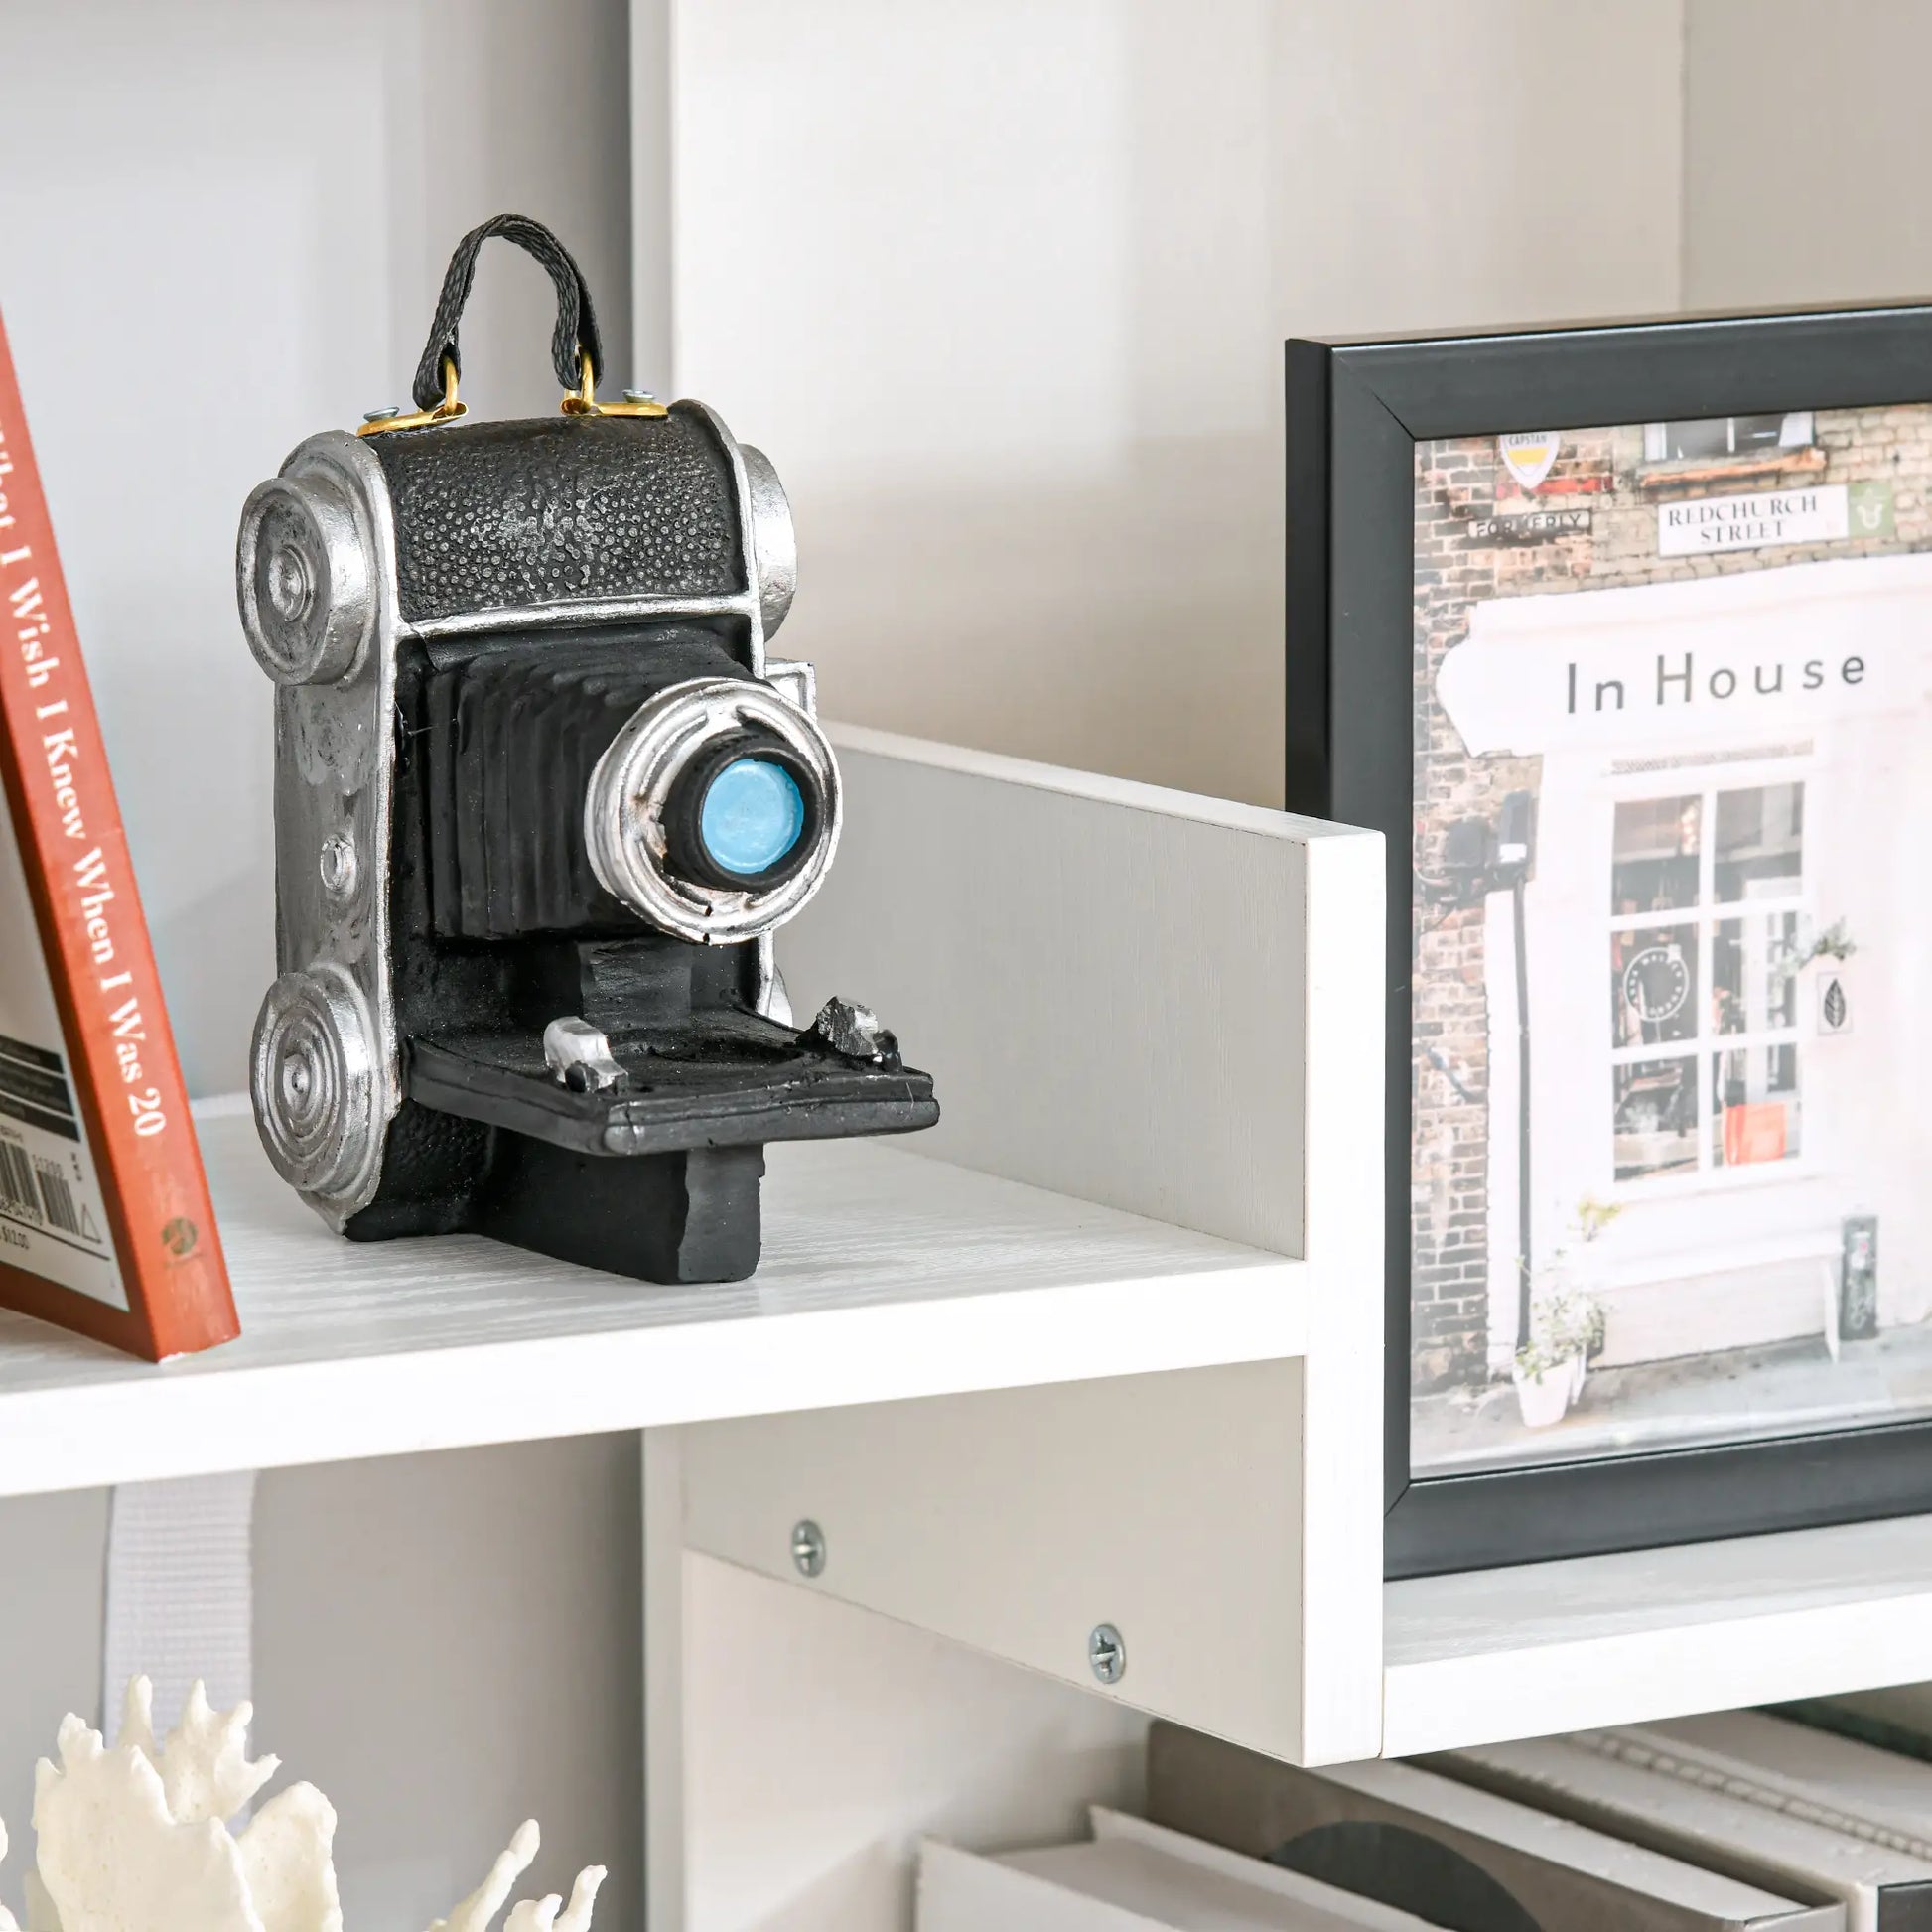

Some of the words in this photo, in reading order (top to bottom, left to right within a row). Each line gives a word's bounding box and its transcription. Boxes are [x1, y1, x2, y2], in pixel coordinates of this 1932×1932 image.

[1669, 495, 1818, 527] REDCHURCH
[1700, 520, 1784, 545] STREET
[0, 546, 32, 567] I
[9, 576, 60, 688] Wish
[1568, 662, 1625, 714] In
[1656, 651, 1865, 706] House
[36, 699, 69, 720] I
[42, 727, 86, 840] Knew
[73, 847, 115, 965] When
[100, 971, 132, 993] I
[109, 997, 146, 1084] Was
[127, 1087, 166, 1137] 20
